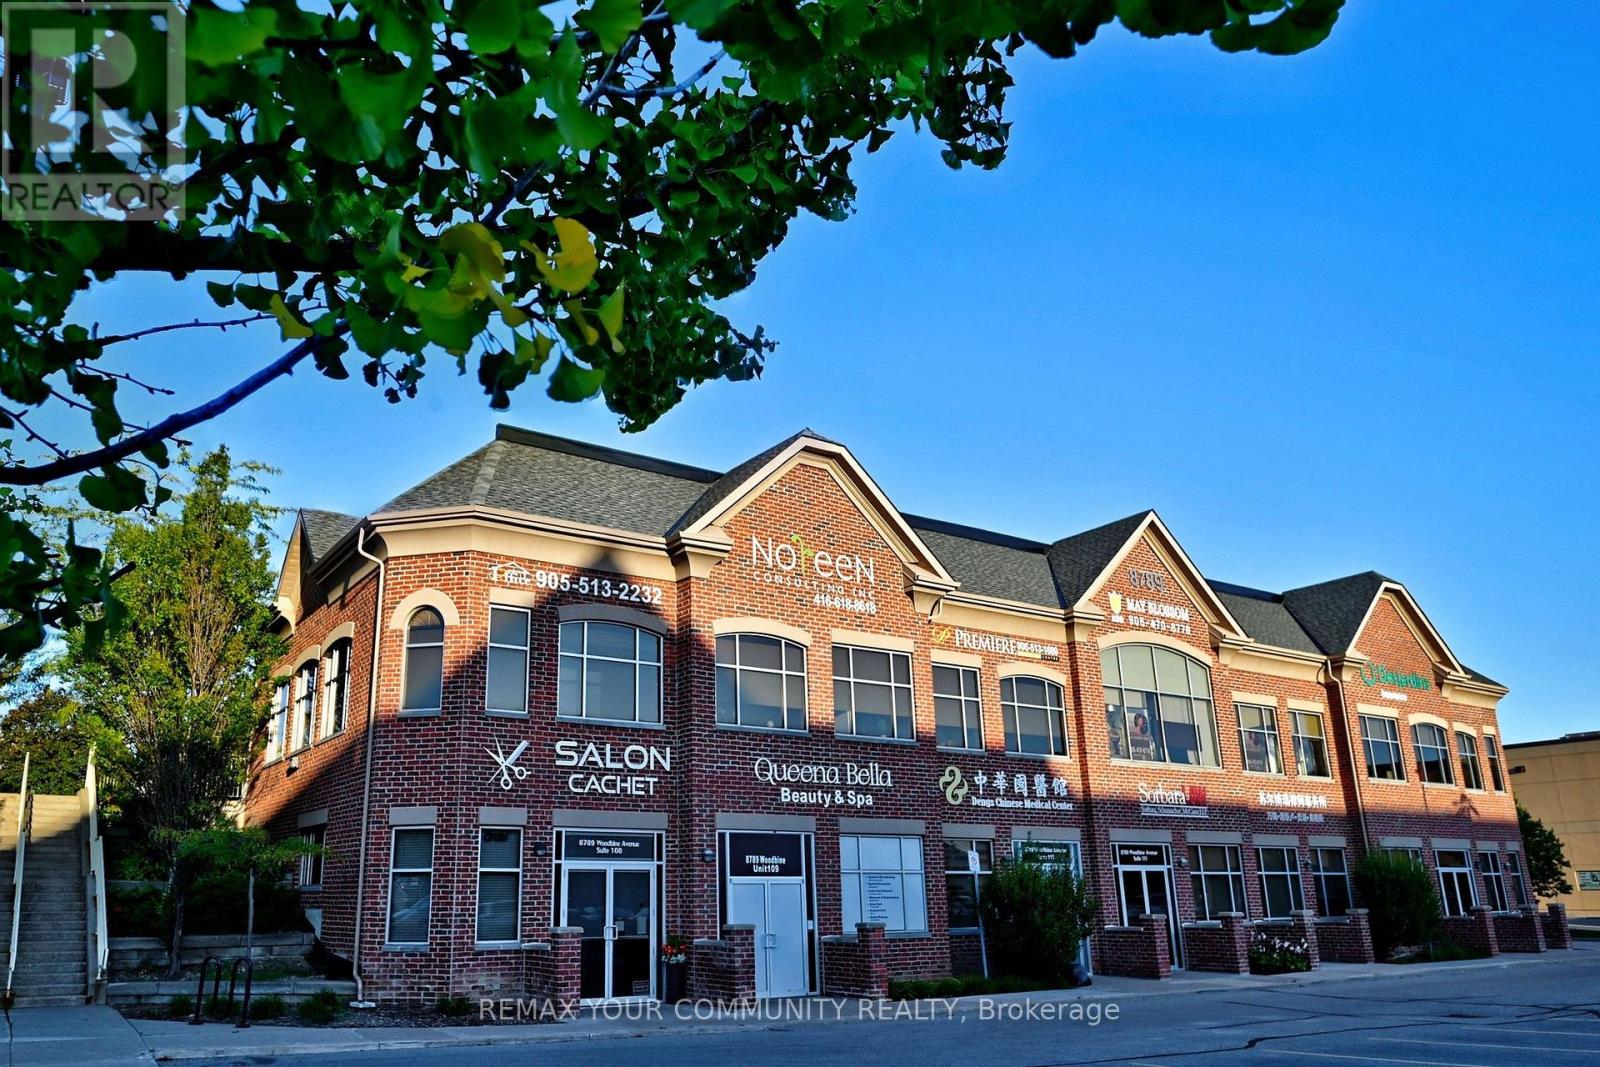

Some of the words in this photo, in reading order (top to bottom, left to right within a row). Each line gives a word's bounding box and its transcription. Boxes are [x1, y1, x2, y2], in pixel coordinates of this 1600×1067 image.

[535, 570, 662, 604] 905-513-2232
[753, 571, 845, 595] CONSULTING
[852, 588, 875, 599] INC
[1126, 597, 1146, 613] MAY
[1147, 601, 1190, 621] BLOSSOM
[954, 628, 1017, 655] PREMIERE
[555, 740, 671, 771] SALON
[754, 757, 841, 785] Queena
[845, 762, 893, 787] Bella
[568, 774, 658, 795] CACHET
[1138, 782, 1187, 805] Sorbara
[781, 787, 831, 808] Beauty
[834, 789, 844, 804] &
[847, 790, 873, 808] Spa
[995, 797, 1024, 808] Chinese
[1024, 799, 1051, 809] Medical
[1051, 801, 1074, 810] Center
[578, 839, 595, 847] 8789
[596, 839, 621, 847] Woodbine
[621, 840, 640, 848] Avenue
[760, 855, 786, 865] Woodbine
